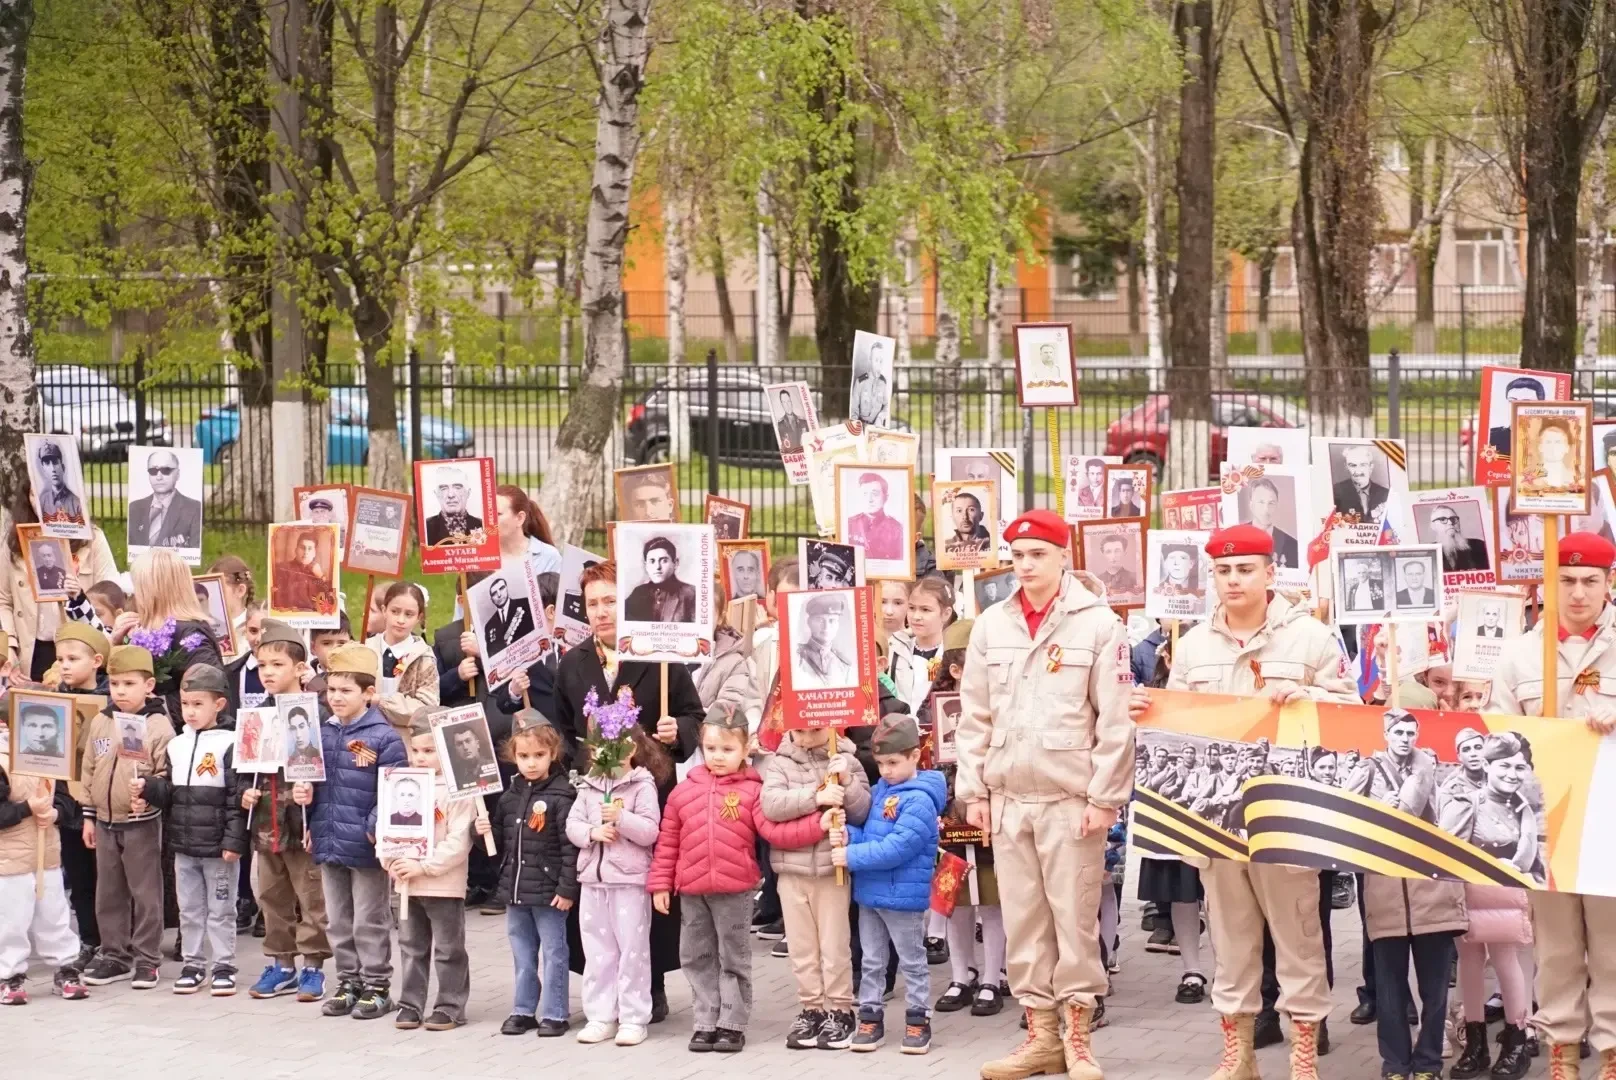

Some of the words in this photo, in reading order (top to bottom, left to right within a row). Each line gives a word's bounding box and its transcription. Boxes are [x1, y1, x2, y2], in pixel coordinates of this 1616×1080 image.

[701, 533, 709, 556] ПОЛК
[444, 548, 477, 556] ХУГАЕВ
[423, 558, 453, 566] Алексей
[454, 555, 500, 564] Михайлович
[524, 560, 532, 578] ПОЛК
[701, 559, 709, 625] БЕССМЕРТНЫЙ
[527, 578, 544, 629] БЕССМЕРТНЫЙ
[651, 623, 679, 631] БИТИЕВ
[861, 613, 871, 676] БЕССМЕРТНЫЙ
[797, 690, 856, 701] ХАЧАТУРОВ
[806, 699, 847, 710] Анатолий
[946, 830, 984, 838] БИЧЕНО
